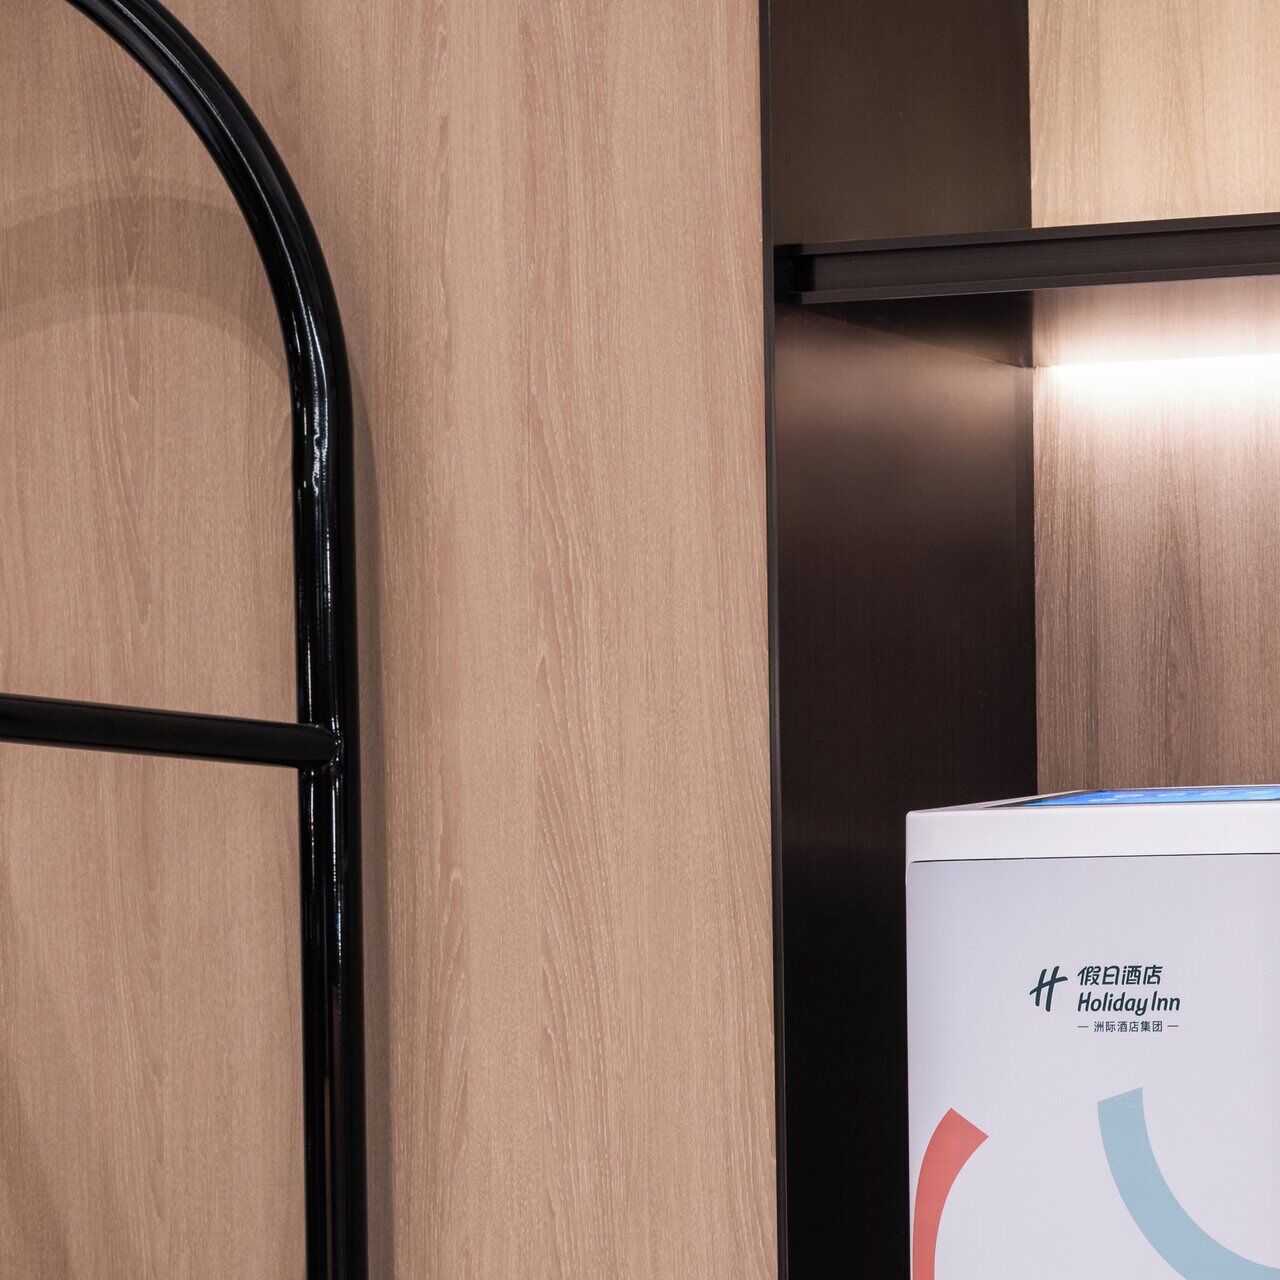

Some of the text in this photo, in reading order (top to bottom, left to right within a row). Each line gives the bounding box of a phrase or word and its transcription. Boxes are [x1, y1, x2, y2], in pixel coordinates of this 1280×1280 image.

[1077, 965, 1163, 986] 假日酒店
[1077, 990, 1181, 1016] Holiday Inn
[1094, 1021, 1163, 1033] 洲际酒店集团
